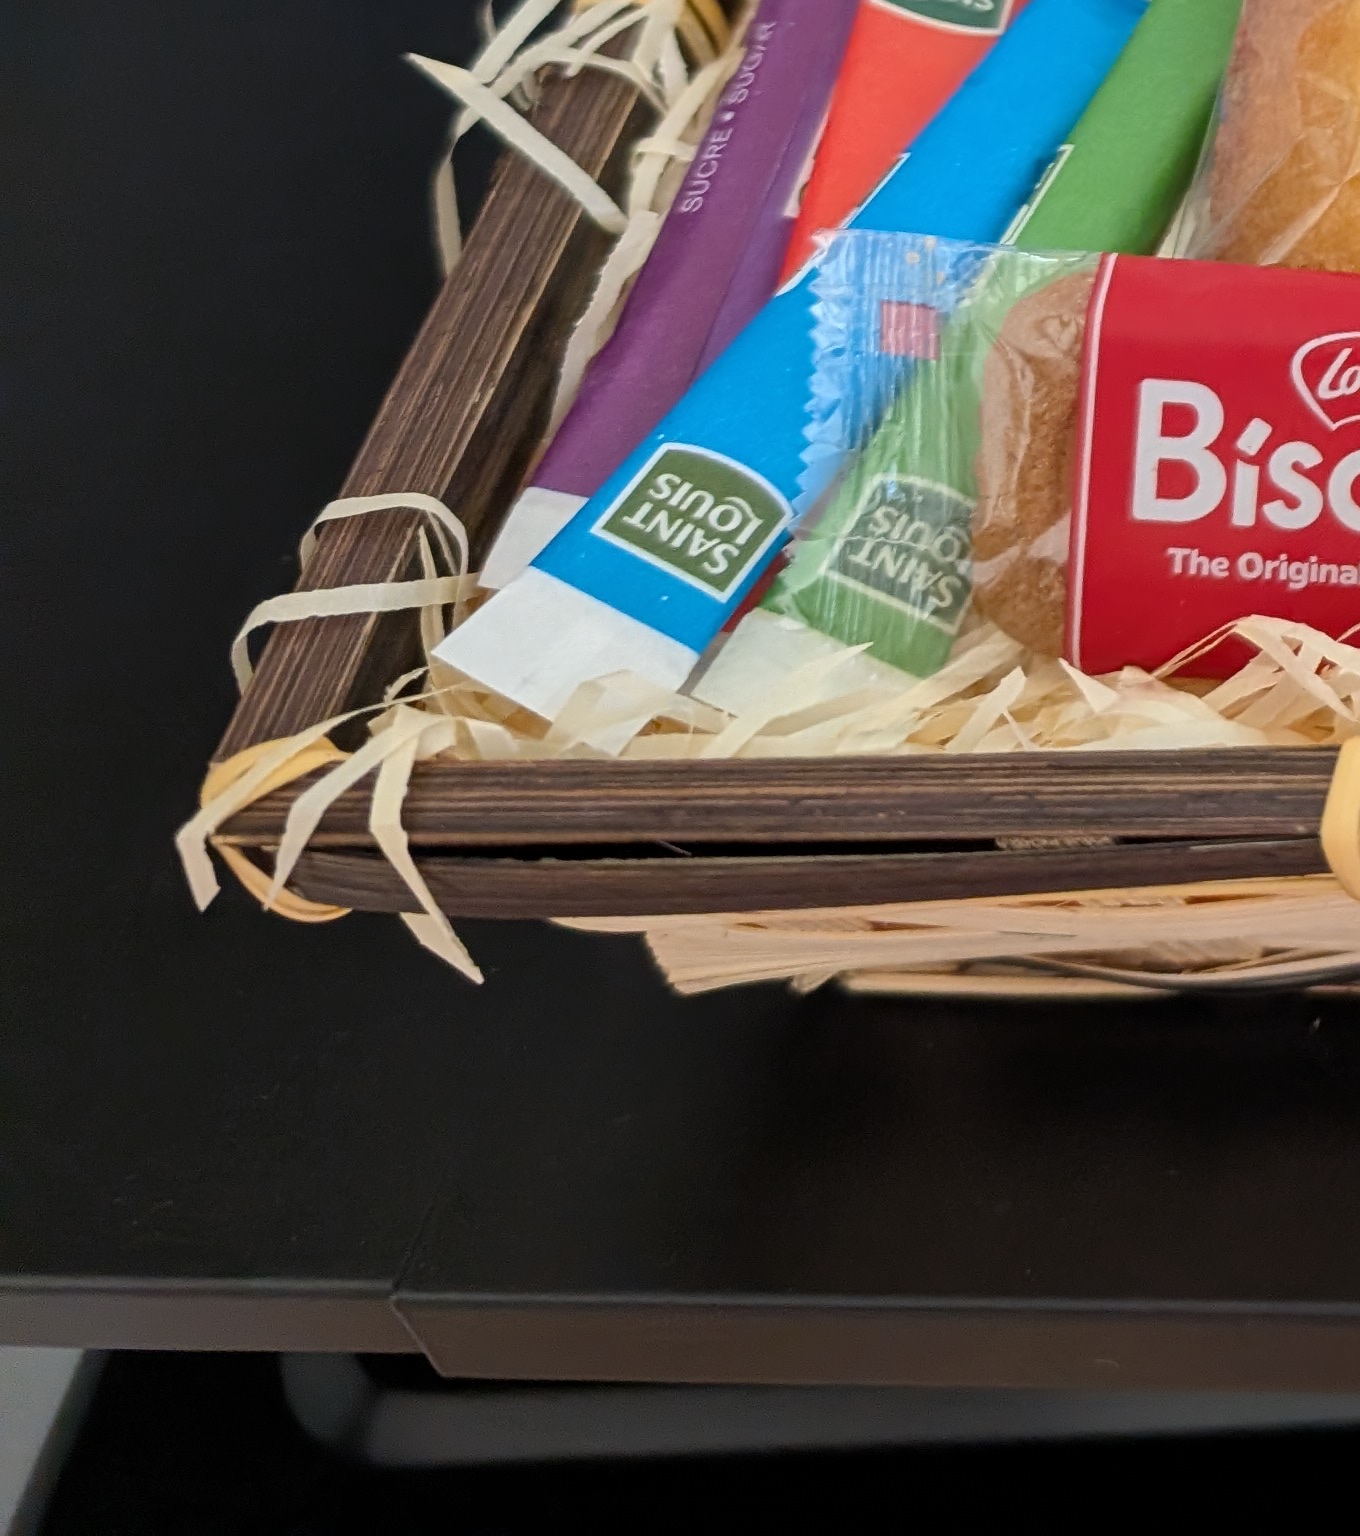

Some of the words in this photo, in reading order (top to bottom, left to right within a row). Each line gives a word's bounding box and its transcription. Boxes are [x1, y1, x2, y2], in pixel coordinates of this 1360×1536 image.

[679, 127, 733, 213] SUCRE
[624, 504, 741, 575] SAINT
[649, 473, 764, 545] LOUIS
[849, 541, 963, 608] SAINT
[1167, 546, 1229, 579] The
